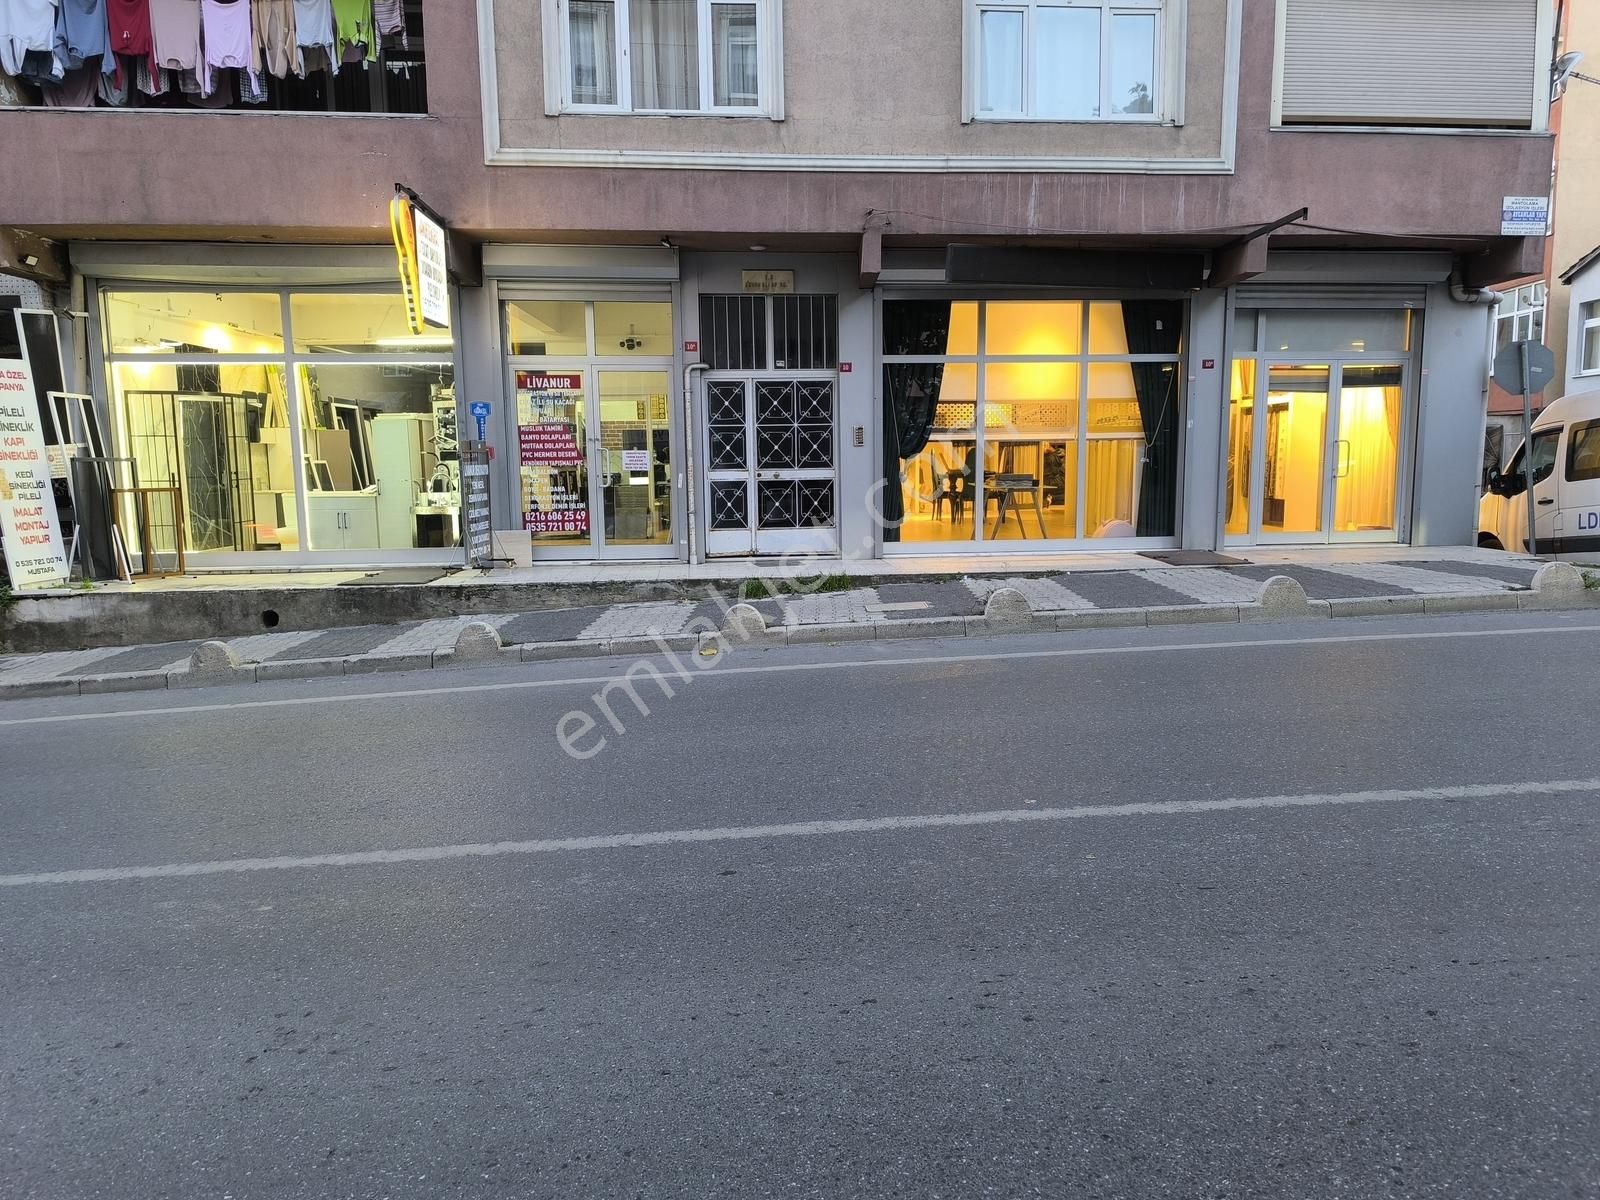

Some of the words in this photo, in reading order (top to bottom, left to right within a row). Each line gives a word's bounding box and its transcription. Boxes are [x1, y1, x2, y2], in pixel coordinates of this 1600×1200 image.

[6, 369, 28, 380] ÖZEL
[526, 375, 571, 389] LİVANUR
[544, 424, 563, 432] TAMİRİ
[3, 436, 25, 447] KAPI
[15, 469, 34, 479] KEDİ
[18, 491, 42, 501] PİLELİ
[13, 506, 43, 517] İMALAT
[525, 512, 545, 521] 0216
[547, 512, 562, 520] 606
[564, 511, 574, 520] 25
[576, 511, 586, 520] 49
[1578, 511, 1600, 530] LD
[15, 521, 50, 532] MONTAJ
[526, 522, 546, 531] 0535
[547, 522, 562, 531] 721
[564, 522, 574, 531] 00
[576, 522, 586, 531] 74
[20, 534, 51, 545] YAPILIR
[27, 566, 56, 575] MUSTAFA
